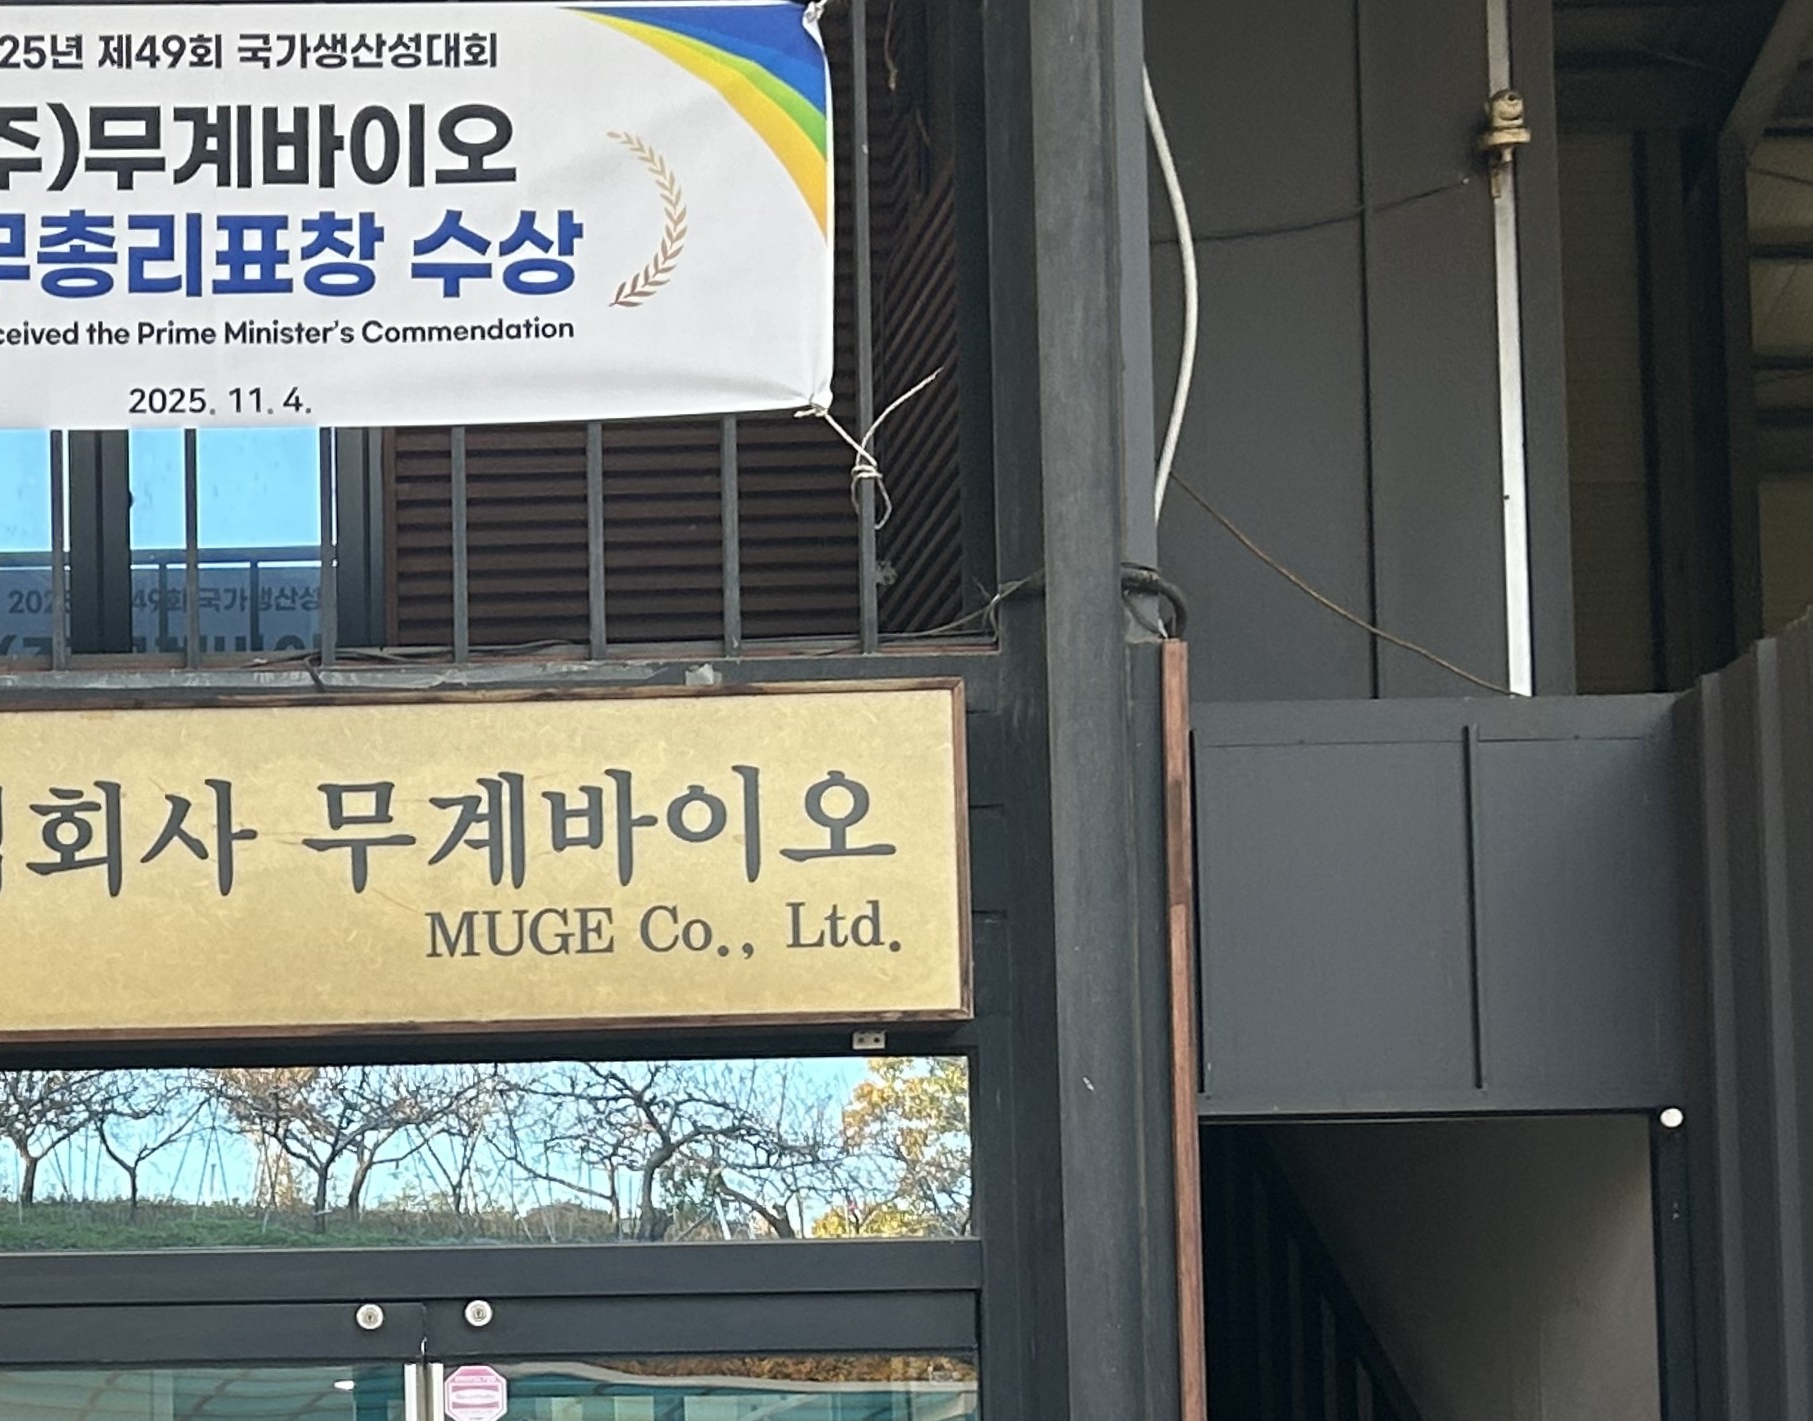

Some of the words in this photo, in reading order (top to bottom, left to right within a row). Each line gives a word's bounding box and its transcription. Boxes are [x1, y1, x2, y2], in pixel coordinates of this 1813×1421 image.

[98, 34, 223, 70] 제49회
[237, 32, 498, 70] 국가생산성대회
[410, 208, 585, 299] 수상
[86, 321, 130, 345] the
[137, 320, 217, 345] Prime
[362, 316, 574, 344] Commendation
[128, 387, 217, 415] 2025.
[229, 387, 275, 414] 11.
[282, 386, 313, 415] 4.
[302, 765, 897, 894] 무계바이오
[425, 907, 615, 958] MUGE
[640, 905, 755, 960] Co.,
[787, 900, 902, 954] Ltd.
